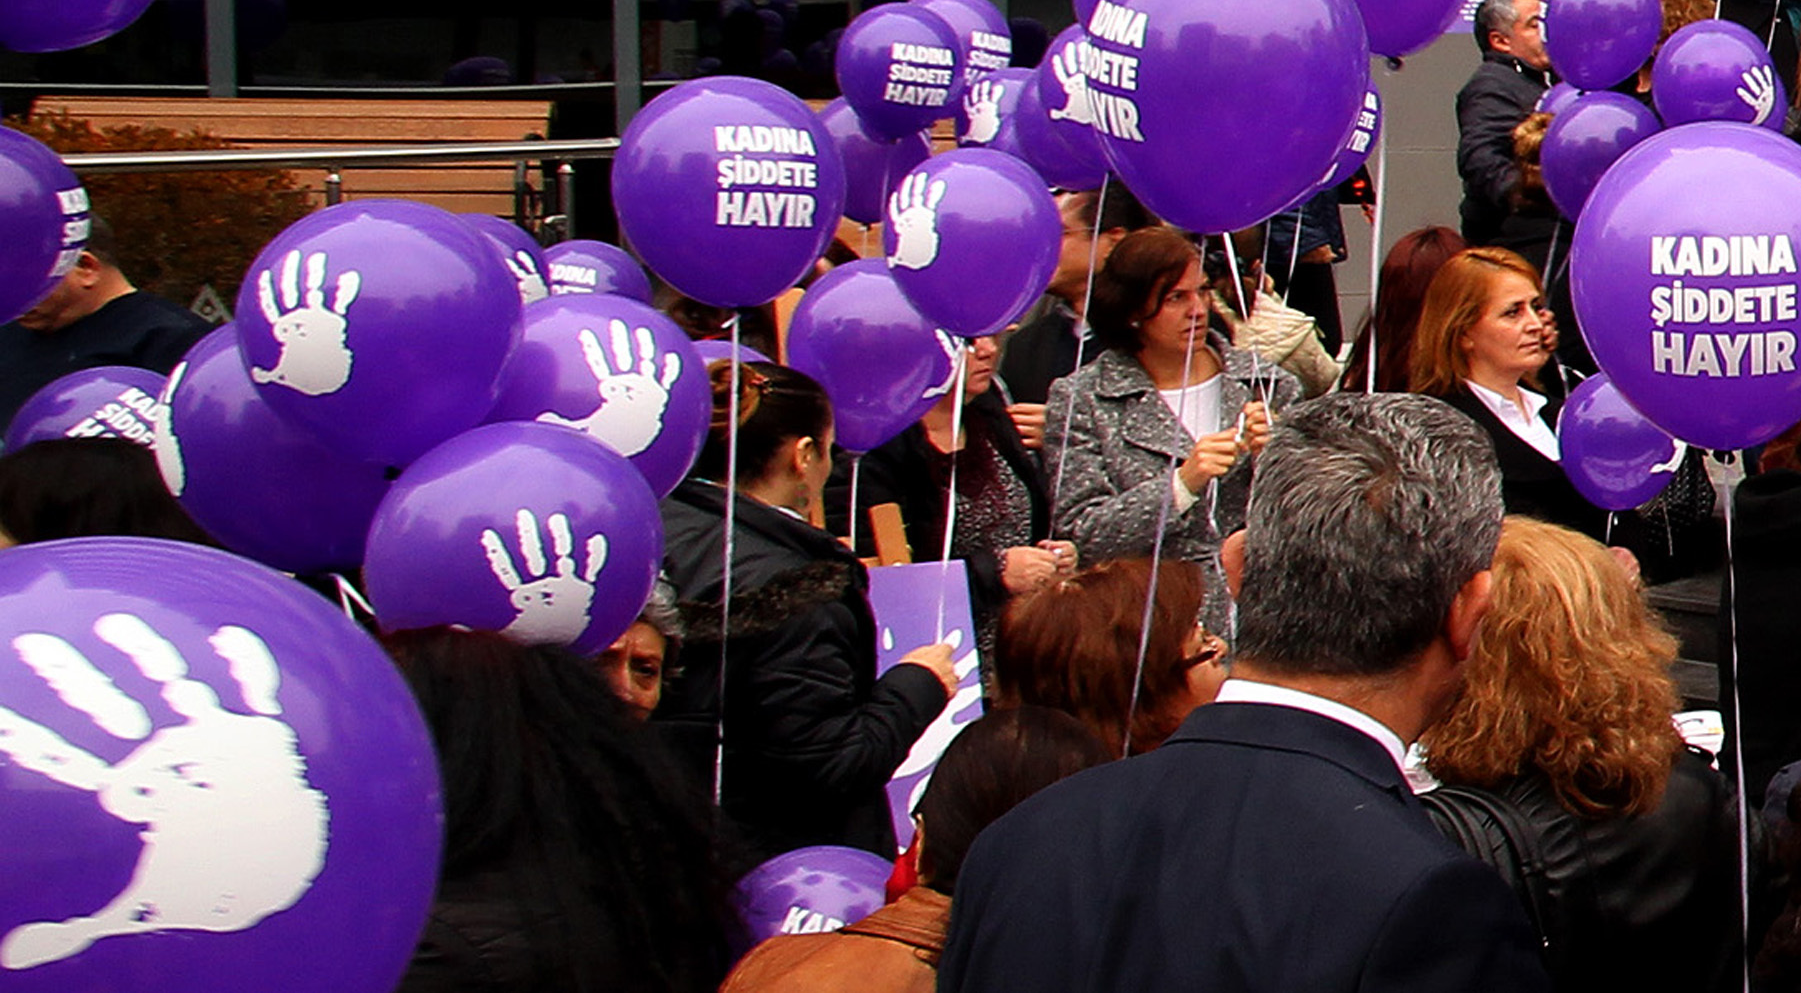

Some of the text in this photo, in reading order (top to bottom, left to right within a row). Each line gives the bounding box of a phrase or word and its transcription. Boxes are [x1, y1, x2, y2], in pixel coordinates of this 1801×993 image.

[891, 42, 954, 66] KADINA
[888, 62, 954, 86] ŞİDDETE
[884, 82, 949, 107] HAYIR
[715, 125, 816, 157] KADINA
[717, 154, 817, 189] ŞİDDETE
[716, 191, 816, 228] HAYIR
[1651, 234, 1797, 277] KADINA
[1650, 280, 1797, 327] ŞİDDETE
[1651, 330, 1797, 378] HAYIR
